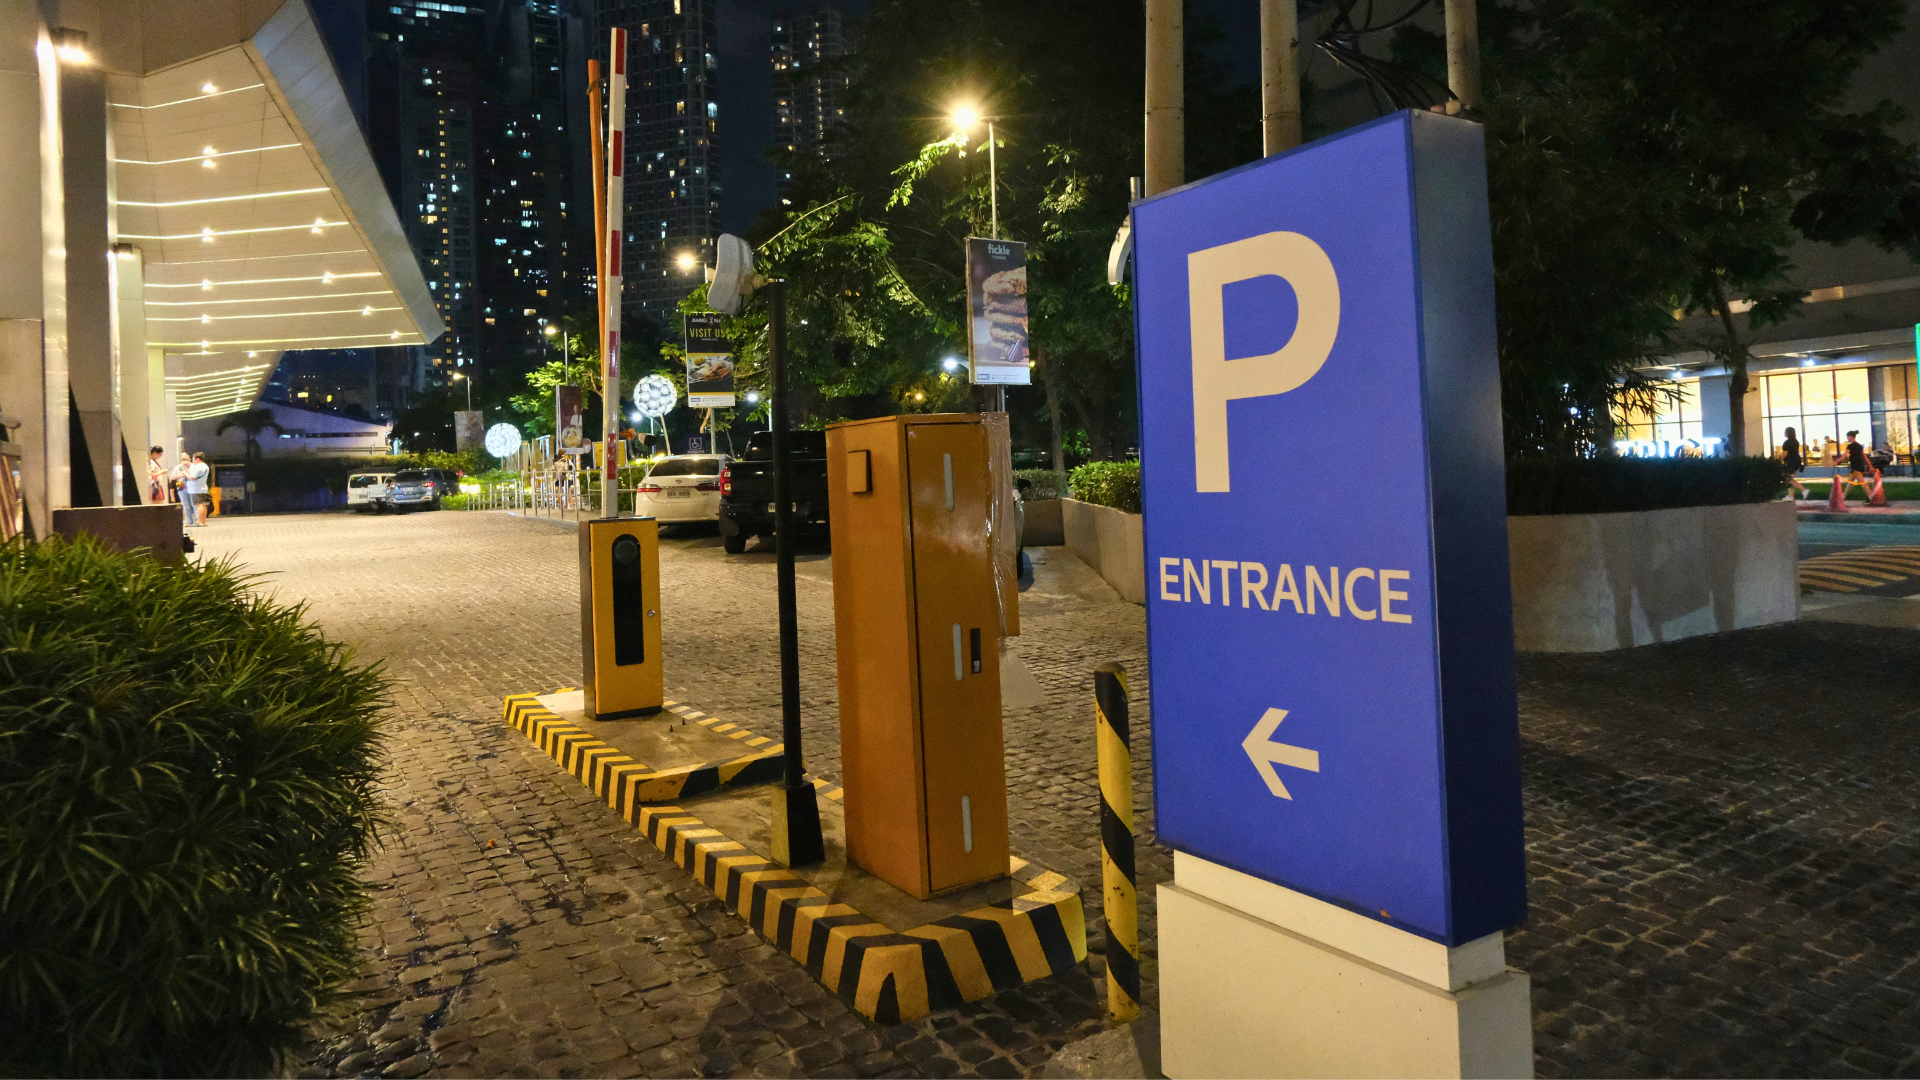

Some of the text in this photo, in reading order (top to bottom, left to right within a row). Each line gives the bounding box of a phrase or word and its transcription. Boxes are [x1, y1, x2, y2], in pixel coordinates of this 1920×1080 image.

[988, 243, 1011, 256] fickle
[689, 328, 726, 338] VISIT US
[1188, 231, 1340, 493] P
[1159, 556, 1412, 624] ENTRANCE
